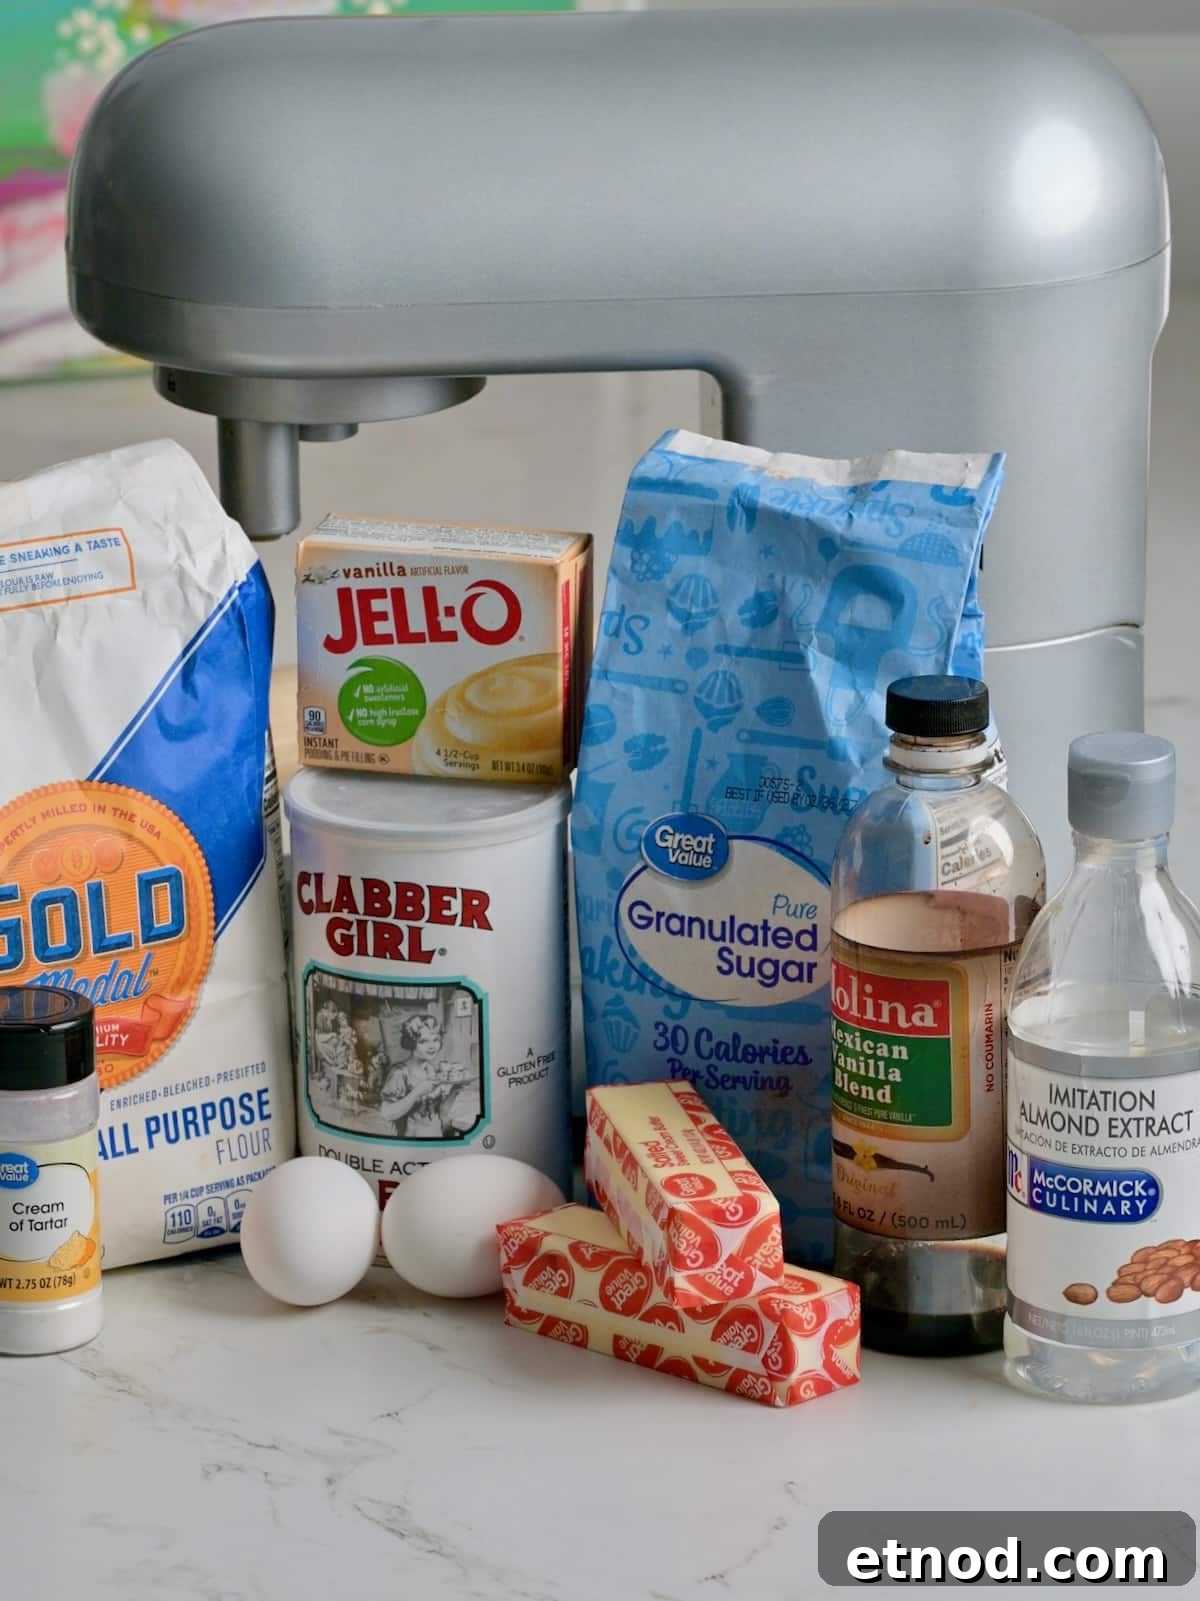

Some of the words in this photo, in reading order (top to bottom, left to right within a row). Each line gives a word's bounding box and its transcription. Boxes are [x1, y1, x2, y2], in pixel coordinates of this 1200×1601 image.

[10, 545, 71, 564] SNEAKING
[74, 542, 83, 553] A
[87, 537, 121, 552] TASTE
[0, 576, 25, 589] LOUR
[343, 561, 407, 579] vanilla
[444, 564, 470, 576] FLAVOR
[308, 710, 321, 721] 90
[304, 736, 339, 749] INSTANT
[40, 803, 87, 821] MILLED
[93, 804, 106, 814] IN
[112, 807, 137, 823] THE
[140, 819, 162, 840] USA
[655, 825, 717, 854] Great
[668, 849, 713, 869] Value
[297, 870, 494, 931] CLABBER
[772, 893, 818, 920] Pure
[326, 916, 438, 964] GIRL
[628, 900, 818, 953] Granulated
[716, 946, 818, 988] Sugar
[96, 1034, 129, 1048] LITY
[653, 1021, 689, 1056] 30
[694, 1027, 813, 1066] Calories
[984, 1003, 995, 1069] COUMARIN
[526, 1048, 534, 1058] A
[667, 1057, 704, 1084] Per
[704, 1063, 792, 1096] Serving
[835, 1068, 893, 1104] Blend
[985, 1074, 995, 1092] NO
[1049, 1083, 1155, 1112] IMITATION
[98, 1122, 139, 1161] ALL
[145, 1087, 272, 1150] PURPOSE
[1020, 1101, 1100, 1137] ALMOND
[1108, 1110, 1194, 1139] EXTRACT
[216, 1127, 272, 1165] FLOUR
[1055, 1140, 1068, 1152] DE
[1071, 1143, 1127, 1159] EXTRACTO
[1132, 1146, 1146, 1158] DE
[0, 1161, 29, 1174] reat
[163, 1192, 178, 1205] PER
[190, 1186, 204, 1198] CUP
[206, 1178, 235, 1194] SERVING
[236, 1175, 245, 1187] AS
[1033, 1168, 1147, 1197] McCORMICK
[12, 1201, 65, 1216] Cream
[843, 1200, 854, 1217] FL
[857, 1207, 875, 1222] OZ
[1032, 1188, 1147, 1215] CULINARY
[9, 1219, 23, 1232] of
[29, 1217, 68, 1232] Tartar
[170, 1209, 192, 1228] 110
[15, 1278, 37, 1290] 2.75
[40, 1278, 52, 1290] OZ
[53, 1272, 76, 1288] (78g)
[605, 1269, 633, 1295] Value
[611, 1271, 648, 1311] Great
[704, 1271, 735, 1296] alue
